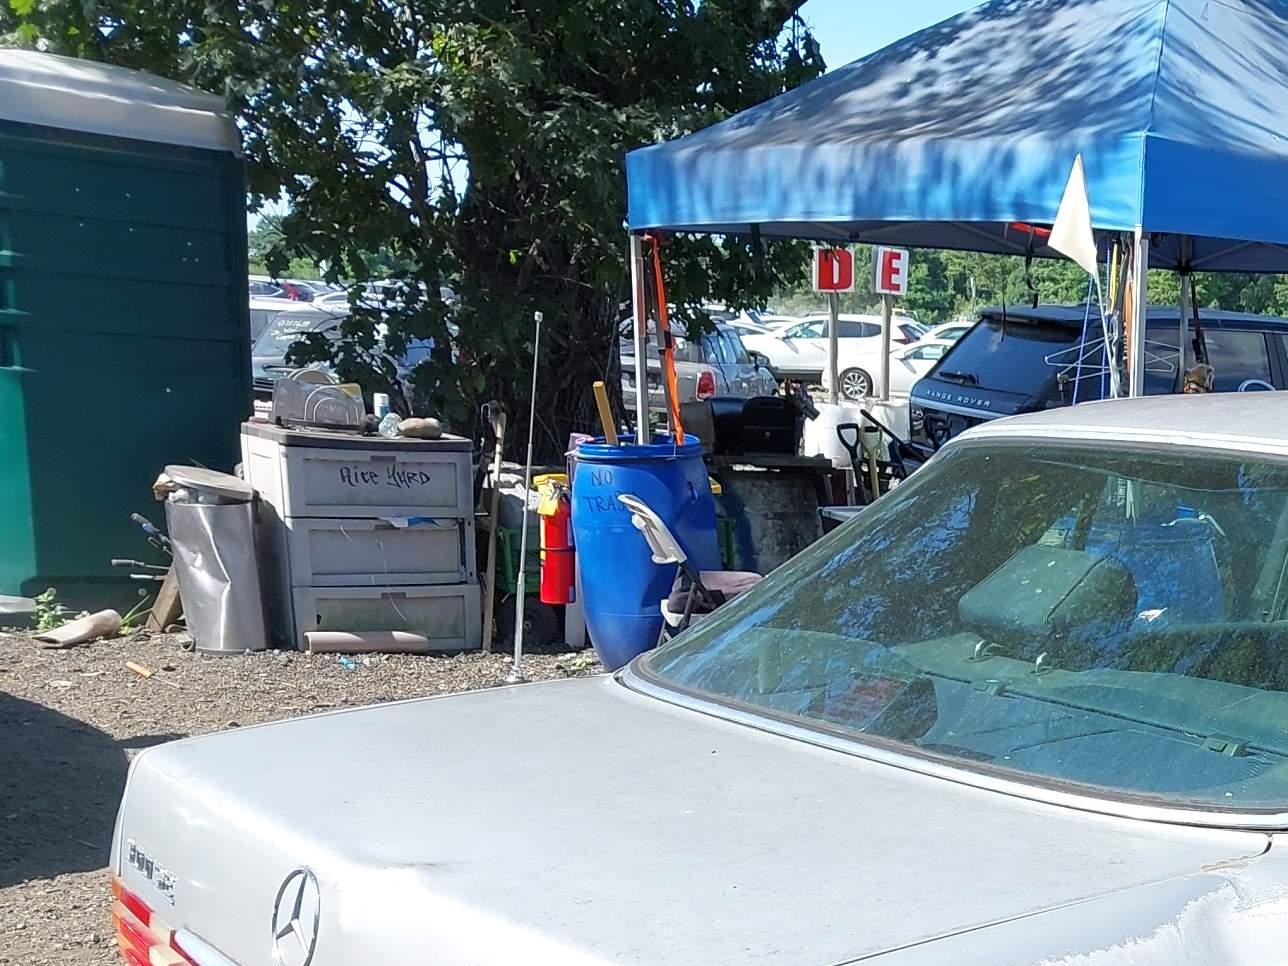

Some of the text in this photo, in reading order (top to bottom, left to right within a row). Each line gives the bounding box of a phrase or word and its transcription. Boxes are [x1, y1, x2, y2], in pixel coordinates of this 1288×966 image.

[818, 248, 852, 290] D
[882, 251, 902, 292] E
[958, 395, 991, 408] ROVER
[591, 470, 613, 486] NO
